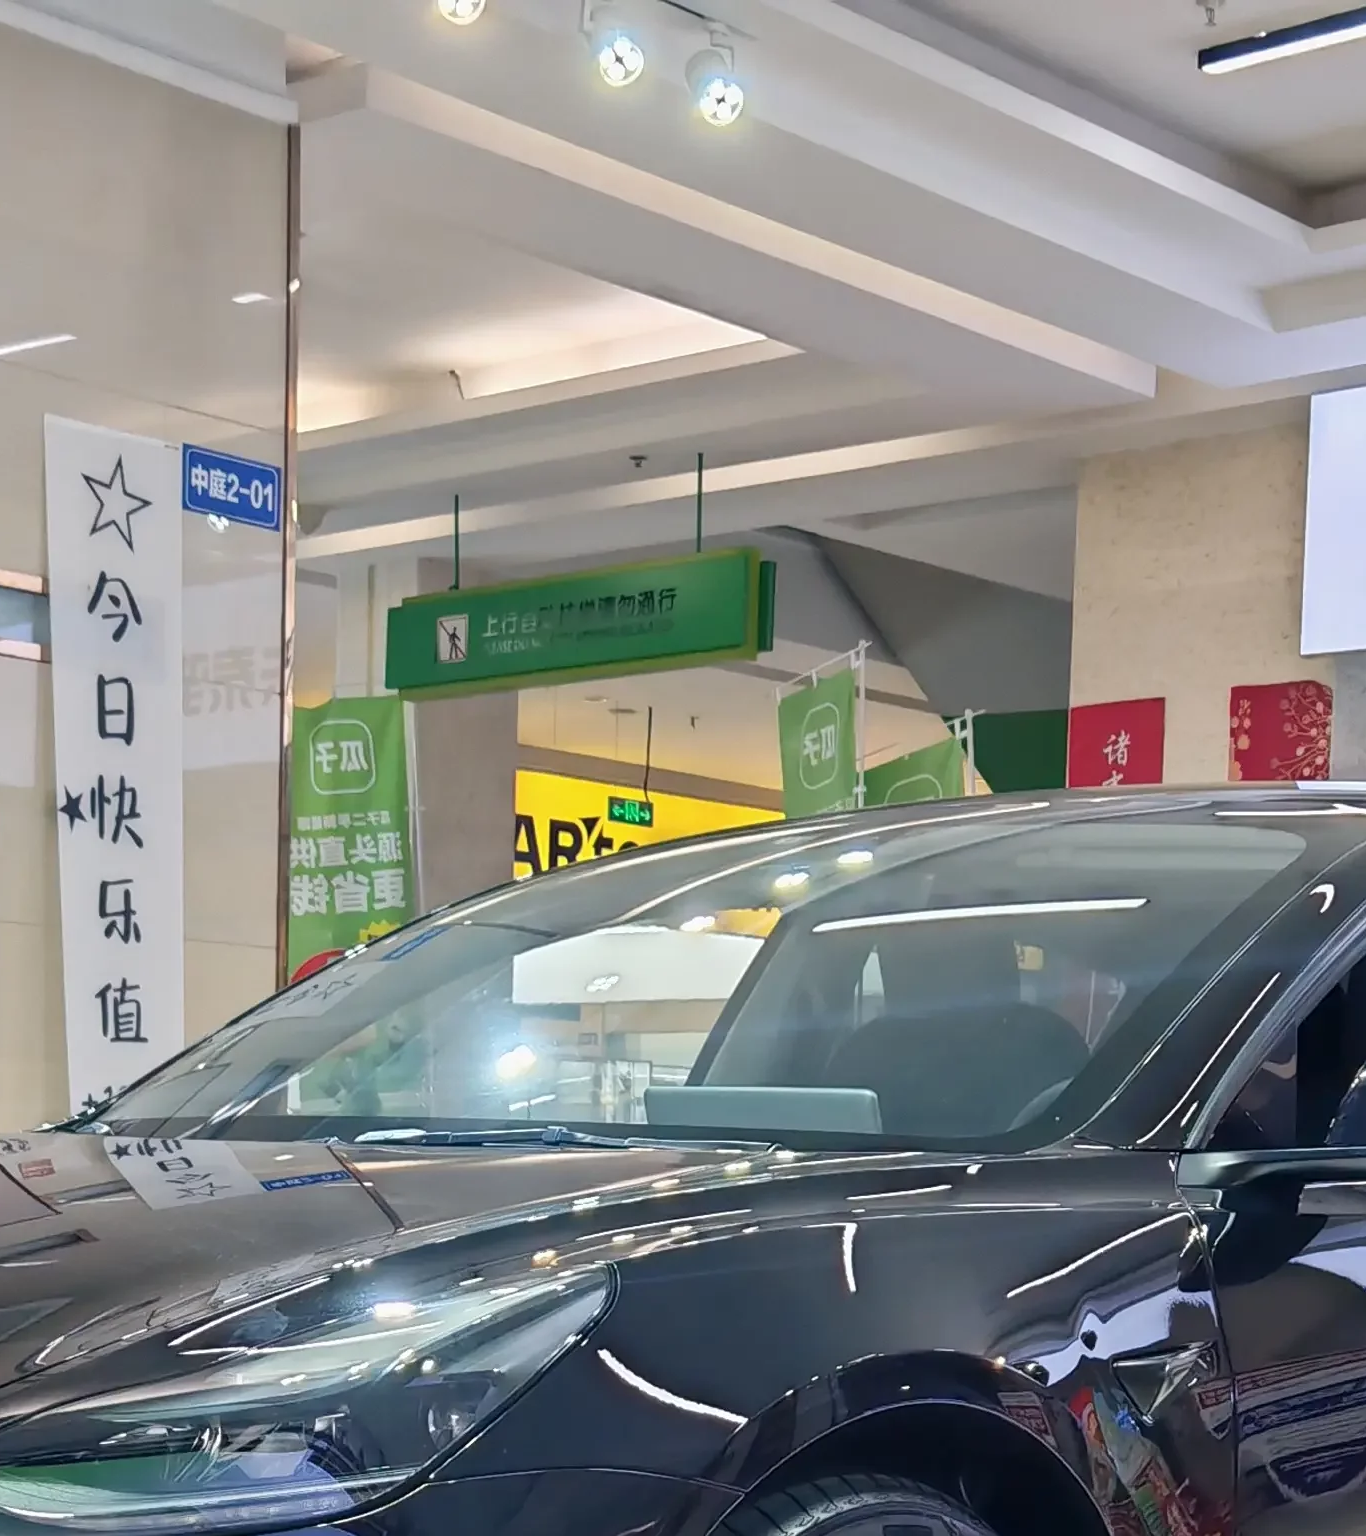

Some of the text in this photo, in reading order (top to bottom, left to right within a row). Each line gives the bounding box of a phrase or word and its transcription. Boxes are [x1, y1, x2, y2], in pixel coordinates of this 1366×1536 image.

[191, 463, 274, 512] 中庭2-01
[86, 569, 149, 1044] 今日快乐值
